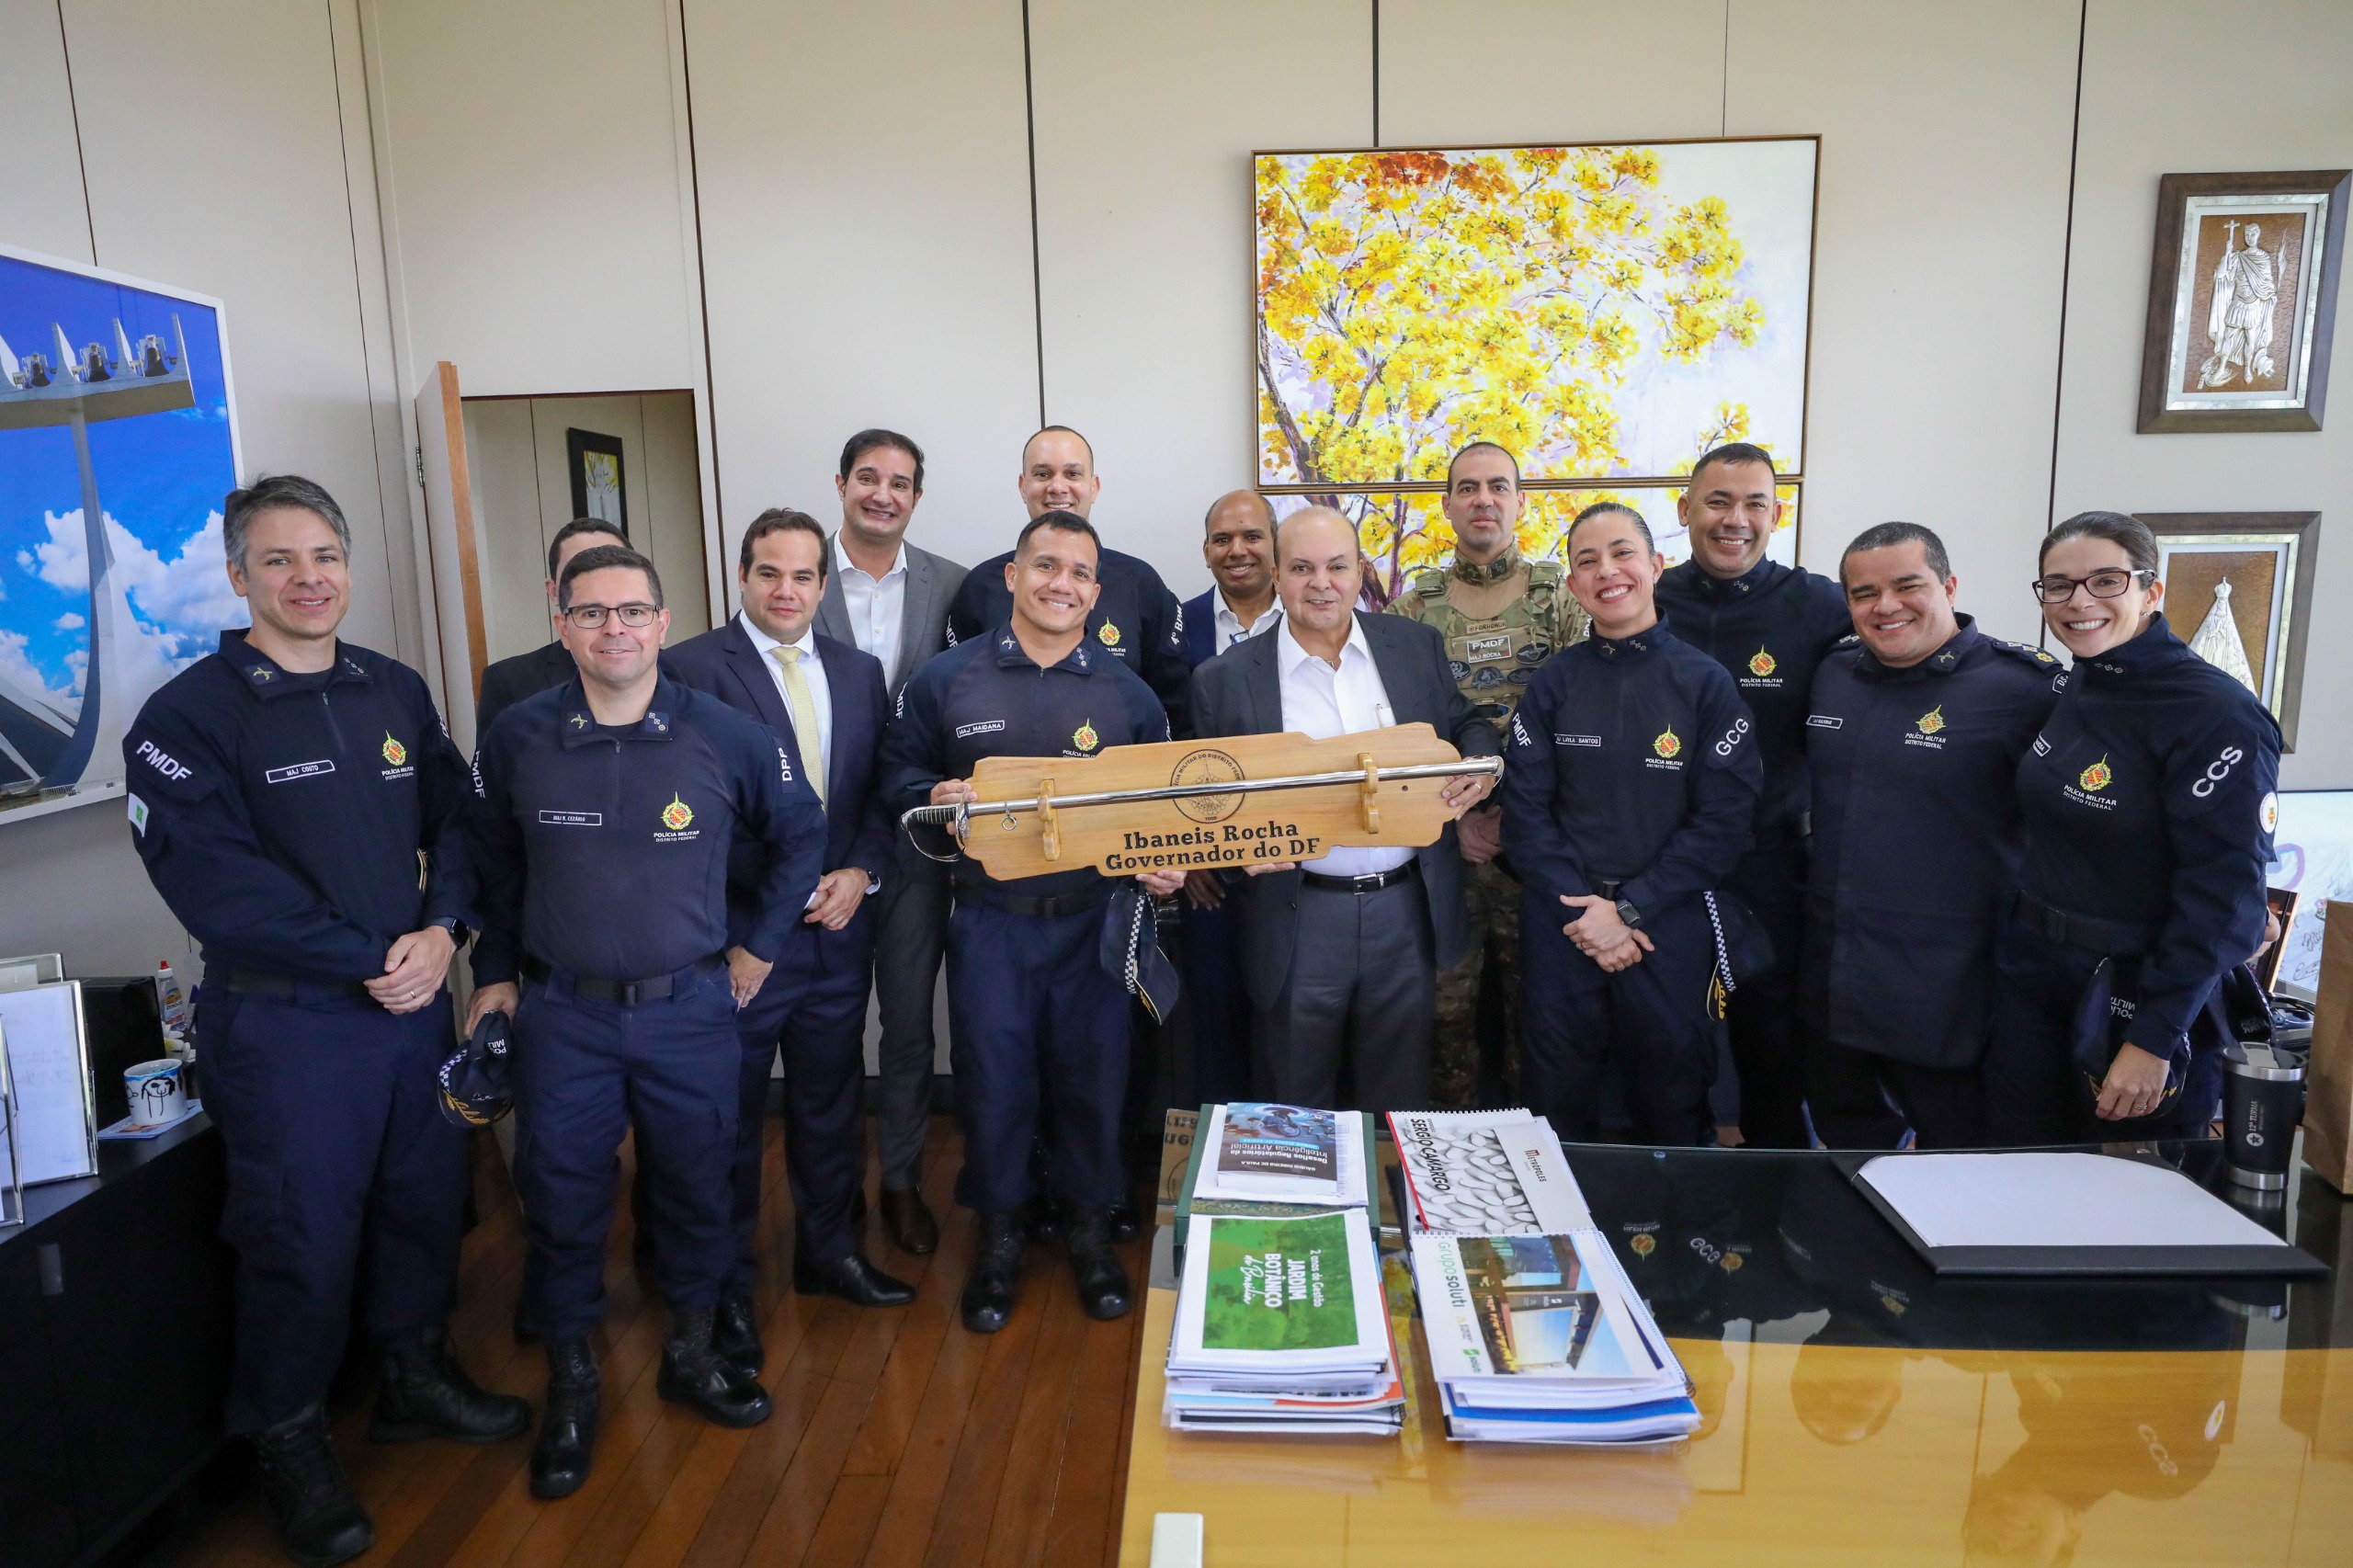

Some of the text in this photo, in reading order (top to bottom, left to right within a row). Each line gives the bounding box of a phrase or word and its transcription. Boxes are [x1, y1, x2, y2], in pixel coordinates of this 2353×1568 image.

[1472, 638, 1506, 650] PMDF
[959, 722, 1002, 735] MAJ MAIDANA
[1512, 711, 1532, 747] PMDF
[1715, 718, 1749, 756] GCG
[1904, 732, 1947, 744] POLÍCIA MILITAR
[1924, 742, 1942, 750] FEDERAL
[136, 740, 193, 780] PMDF
[1179, 756, 1198, 773] MILITAR
[1208, 753, 1233, 767] DISTRITO
[286, 765, 319, 777] MAJ COUTO
[381, 766, 401, 777] POLÍCIA
[2192, 745, 2243, 798] CCS
[2063, 784, 2117, 806] POLÍCIA MILITAR
[2085, 801, 2112, 811] FEDERAL
[1123, 821, 1299, 851] Ibaneis Rocha
[1106, 838, 1321, 870] Governador do DF
[2249, 1100, 2258, 1121] TURMA
[1242, 1150, 1292, 1158] Regulatórios
[1275, 1144, 1327, 1158] Inteligência
[1293, 1153, 1328, 1164] Desafios
[1410, 1119, 1450, 1191] SERGIO CAMARGO
[1244, 1255, 1264, 1266] de
[1311, 1256, 1320, 1271] anos
[1264, 1253, 1287, 1308] BOTÂNICO
[1287, 1258, 1307, 1301] JARDIM
[1312, 1272, 1323, 1281] de
[1313, 1281, 1324, 1307] Gestão
